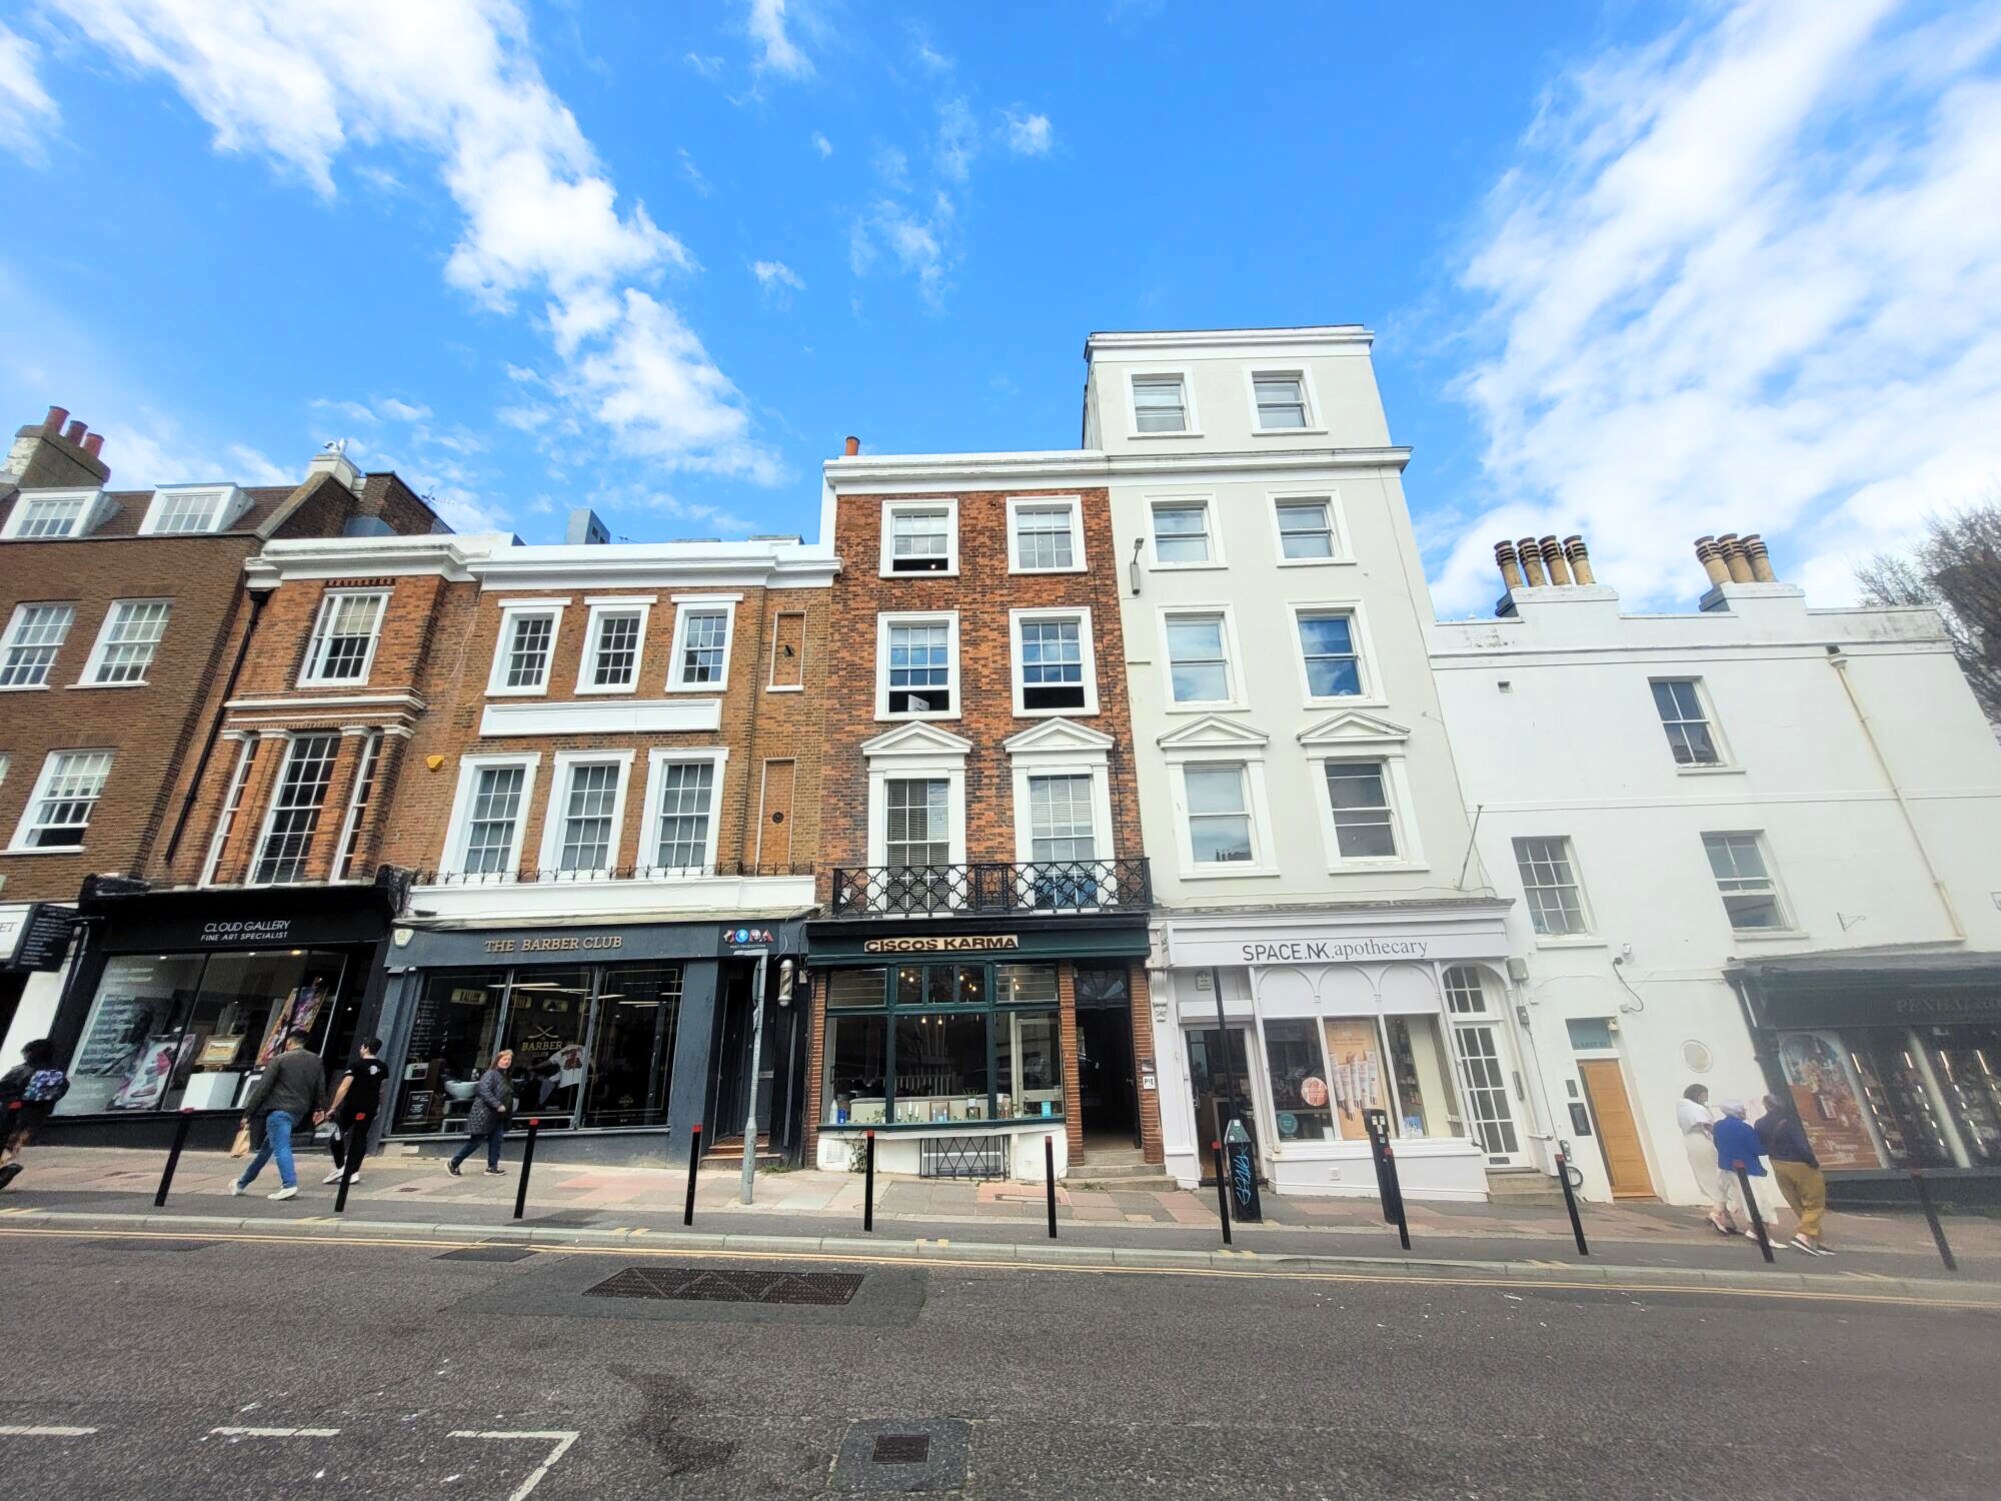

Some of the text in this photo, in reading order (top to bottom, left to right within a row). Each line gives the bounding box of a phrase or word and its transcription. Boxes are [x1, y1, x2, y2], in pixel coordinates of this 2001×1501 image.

[204, 920, 291, 932] CLOUD GALLERY
[221, 933, 238, 941] ART
[240, 931, 288, 940] SPECIALIST
[484, 936, 623, 953] THE BARBER CLUB
[865, 937, 1018, 951] CISCOS KARMA
[521, 1041, 562, 1051] BARBER
